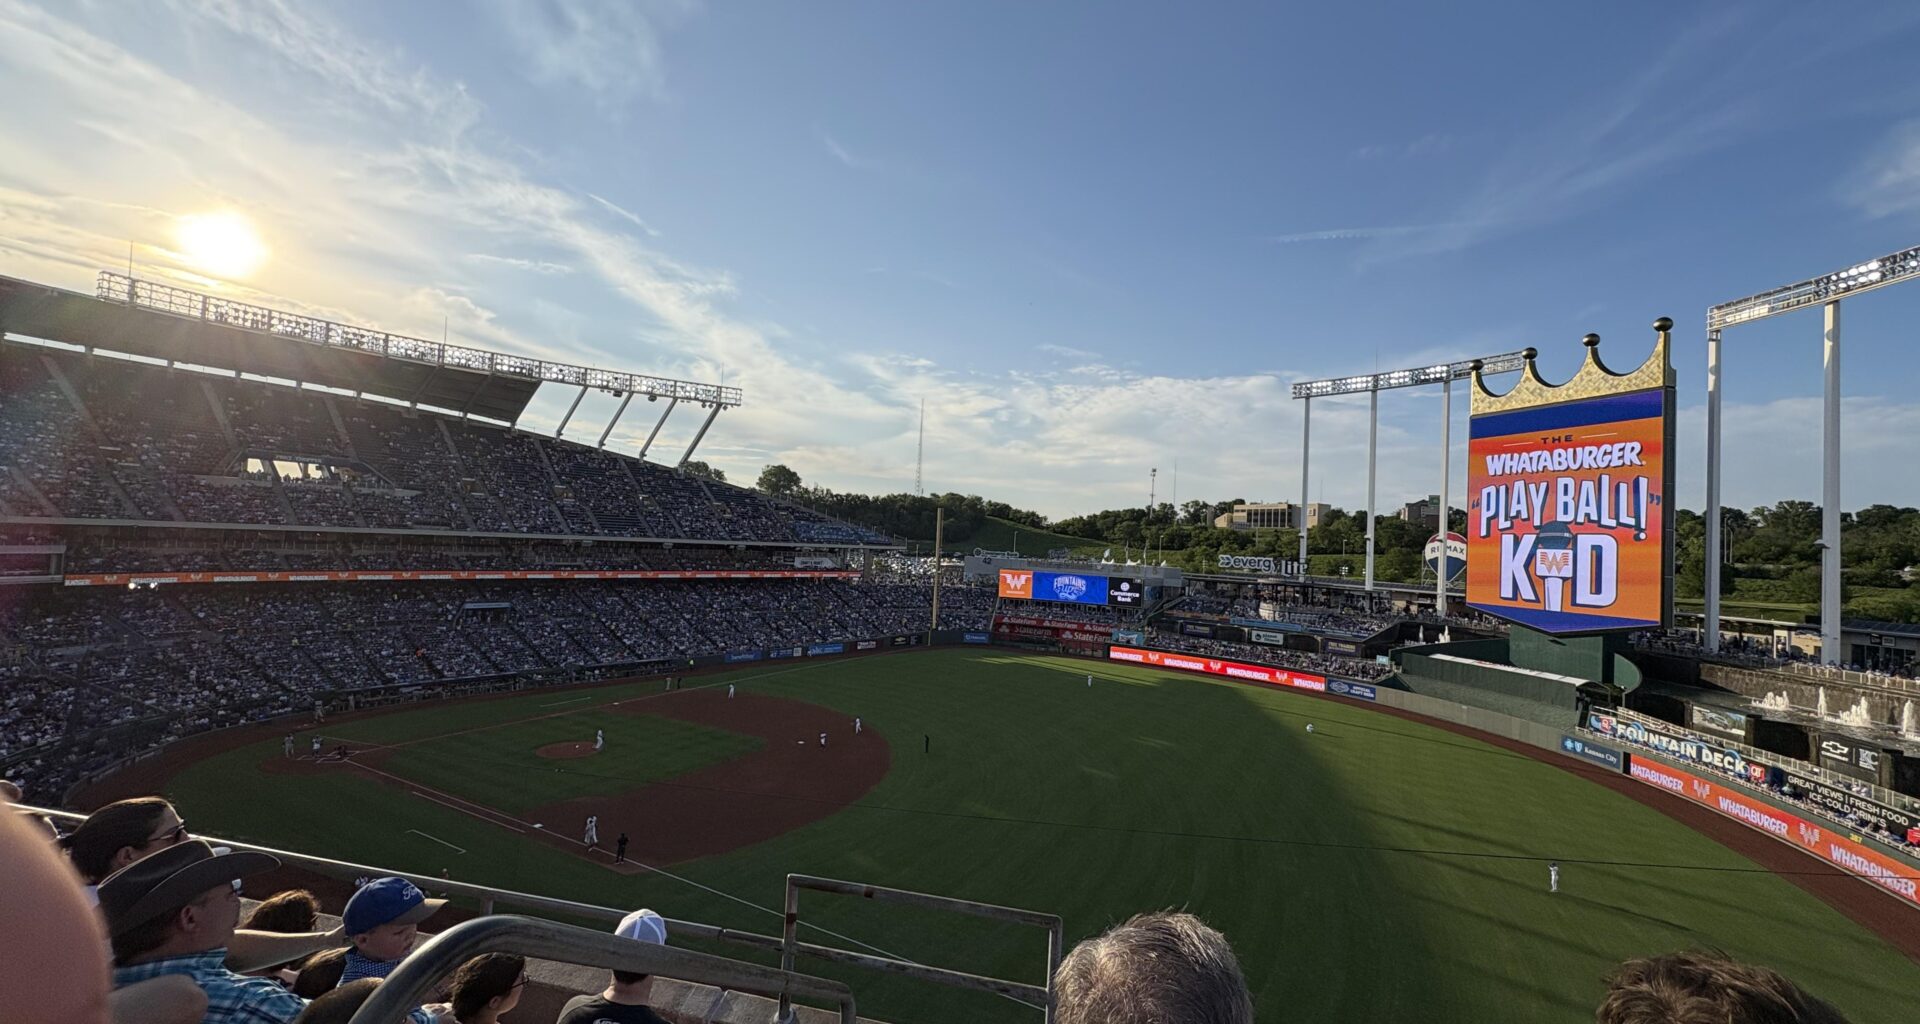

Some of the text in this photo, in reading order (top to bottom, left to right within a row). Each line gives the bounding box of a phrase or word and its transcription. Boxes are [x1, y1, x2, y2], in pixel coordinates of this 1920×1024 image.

[1541, 434, 1573, 444] THE
[1486, 442, 1642, 476] WHATABURGER
[1584, 746, 1617, 765] Kansas City
[1617, 723, 1749, 774] FOUNTAIN DECK
[1719, 795, 1788, 838] WHATABURGER
[1788, 775, 1909, 826] GREAT VIEWS FRESH FOOD
[1809, 791, 1850, 813] ICE-COLD
[1830, 843, 1918, 901] WHATABURGER
